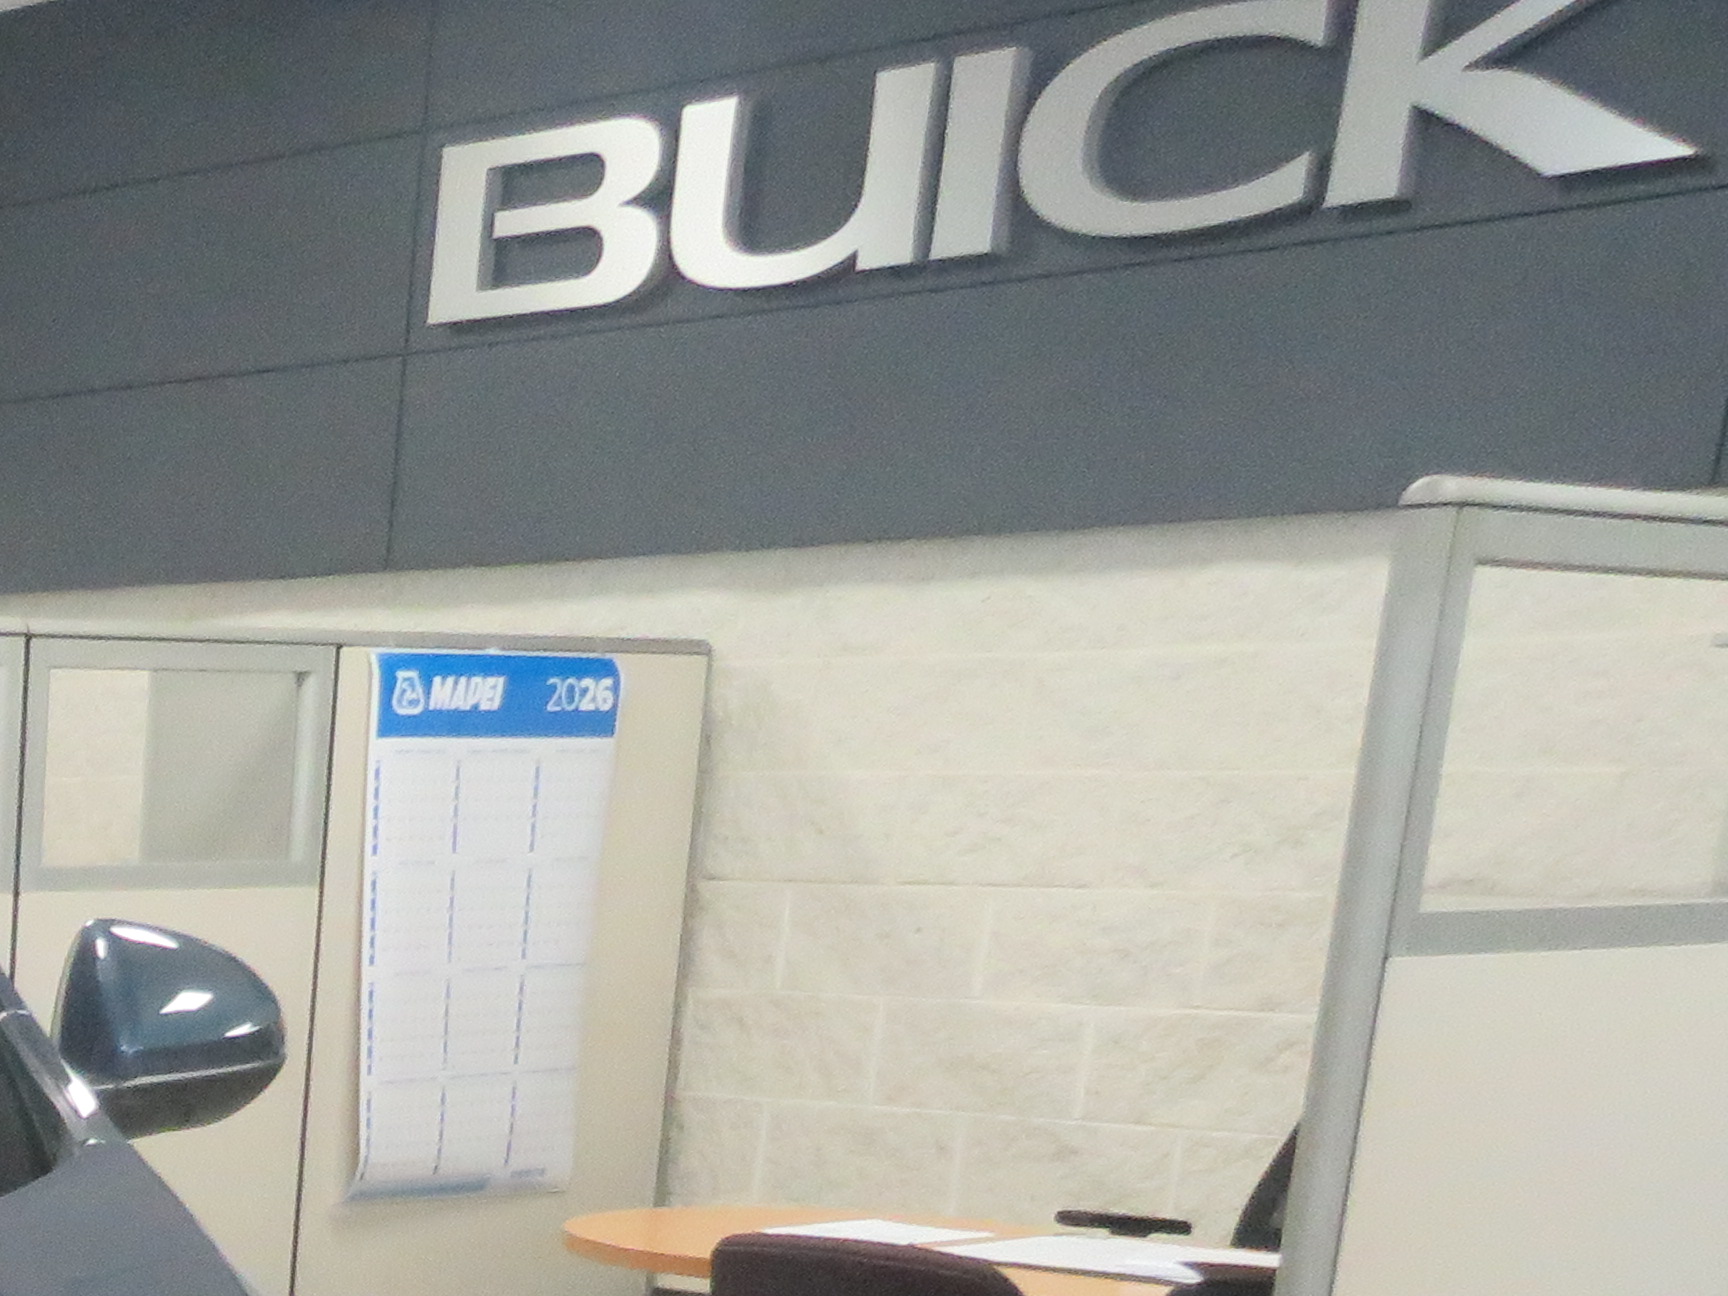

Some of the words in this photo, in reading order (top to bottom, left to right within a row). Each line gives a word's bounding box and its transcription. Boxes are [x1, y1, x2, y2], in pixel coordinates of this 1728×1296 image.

[428, 0, 1700, 324] BUICK
[428, 675, 506, 711] MAPEI
[545, 677, 614, 712] 2026
